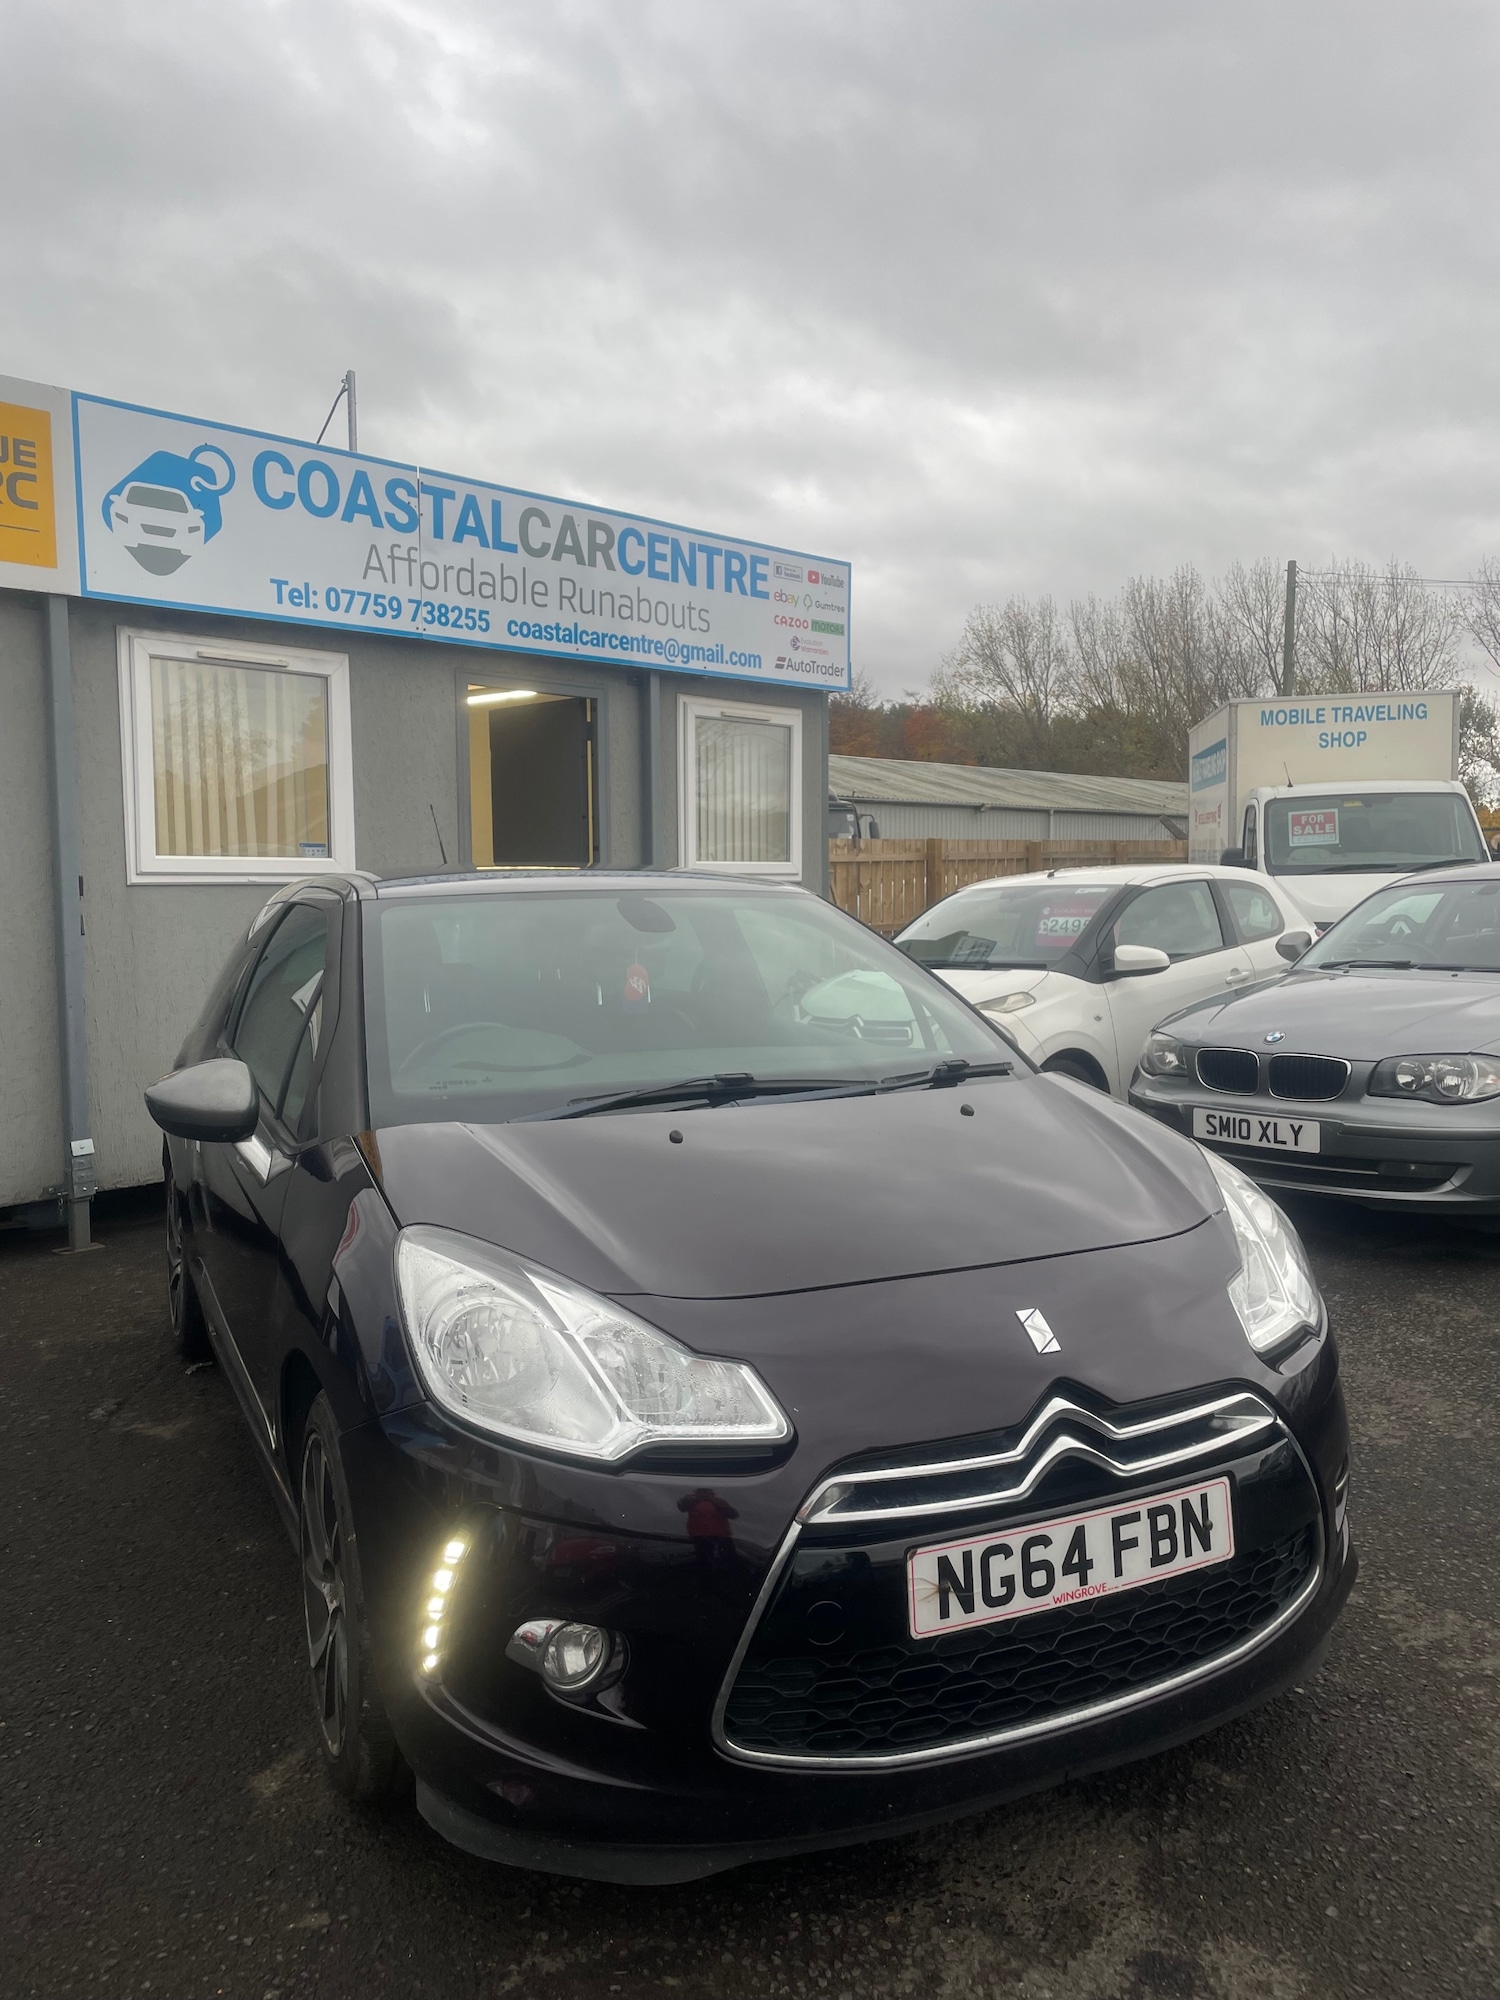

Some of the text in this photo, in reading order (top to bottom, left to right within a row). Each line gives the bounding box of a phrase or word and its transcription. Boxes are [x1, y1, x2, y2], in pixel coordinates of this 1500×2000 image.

[252, 450, 770, 600] COASTALCARCENTRE
[363, 543, 711, 633] Affordable Runabouts
[820, 572, 845, 588] YouTube
[270, 578, 490, 633] Tel: 07759 738255
[774, 589, 799, 607] ebay
[815, 600, 845, 613] Gumtree
[507, 618, 762, 670] coastalcarcentre@gmail.com
[786, 657, 844, 677] AutoTrader
[1260, 703, 1428, 727] MOBILE TRAVELING
[1319, 731, 1367, 749] SHOP
[1293, 824, 1335, 835] SALE
[1301, 814, 1324, 825] FOR
[1205, 1114, 1303, 1147] SM10 XLY
[937, 1492, 1212, 1620] NG64 FBN
[1052, 1582, 1108, 1606] WINGROVE
